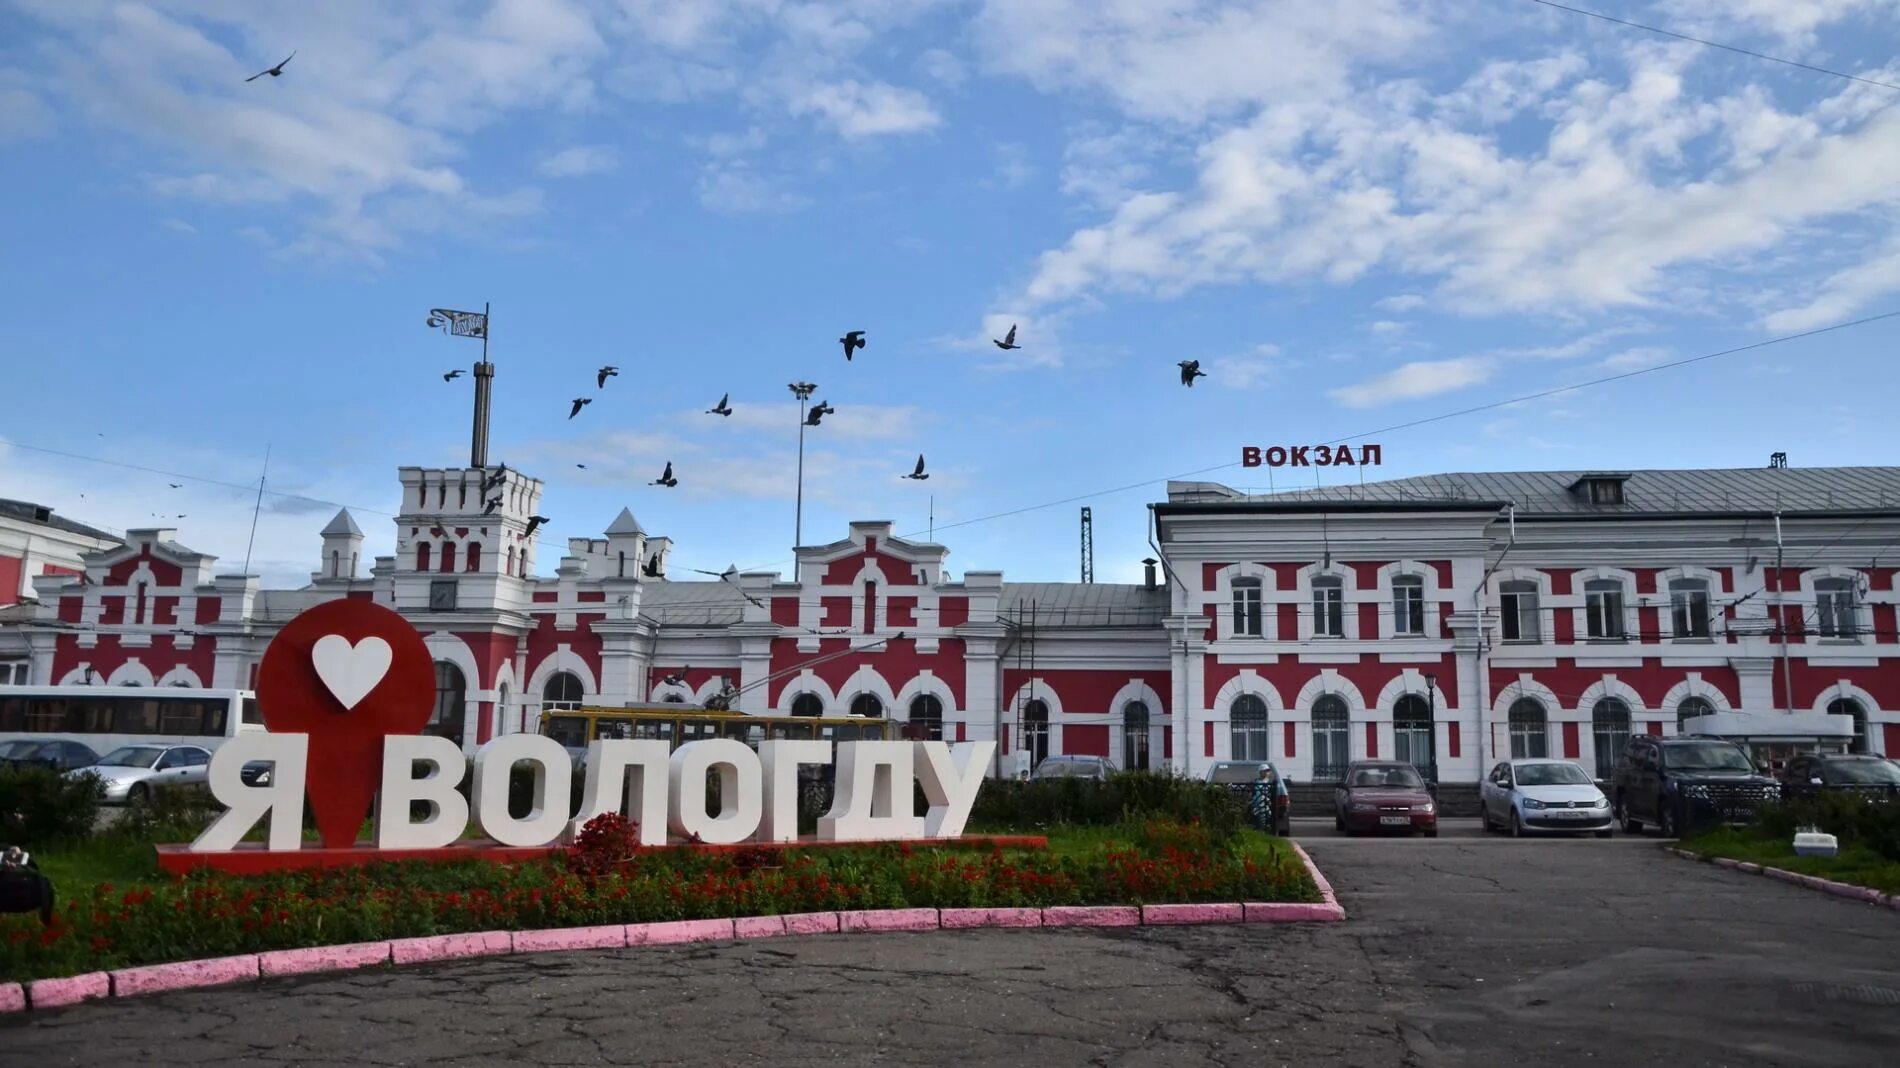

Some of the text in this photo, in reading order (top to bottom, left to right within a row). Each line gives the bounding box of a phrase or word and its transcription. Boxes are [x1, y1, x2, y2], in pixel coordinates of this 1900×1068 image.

[1242, 445, 1381, 467] ВОКЗАЛ
[190, 733, 997, 851] Я ВОЛОГДУ
